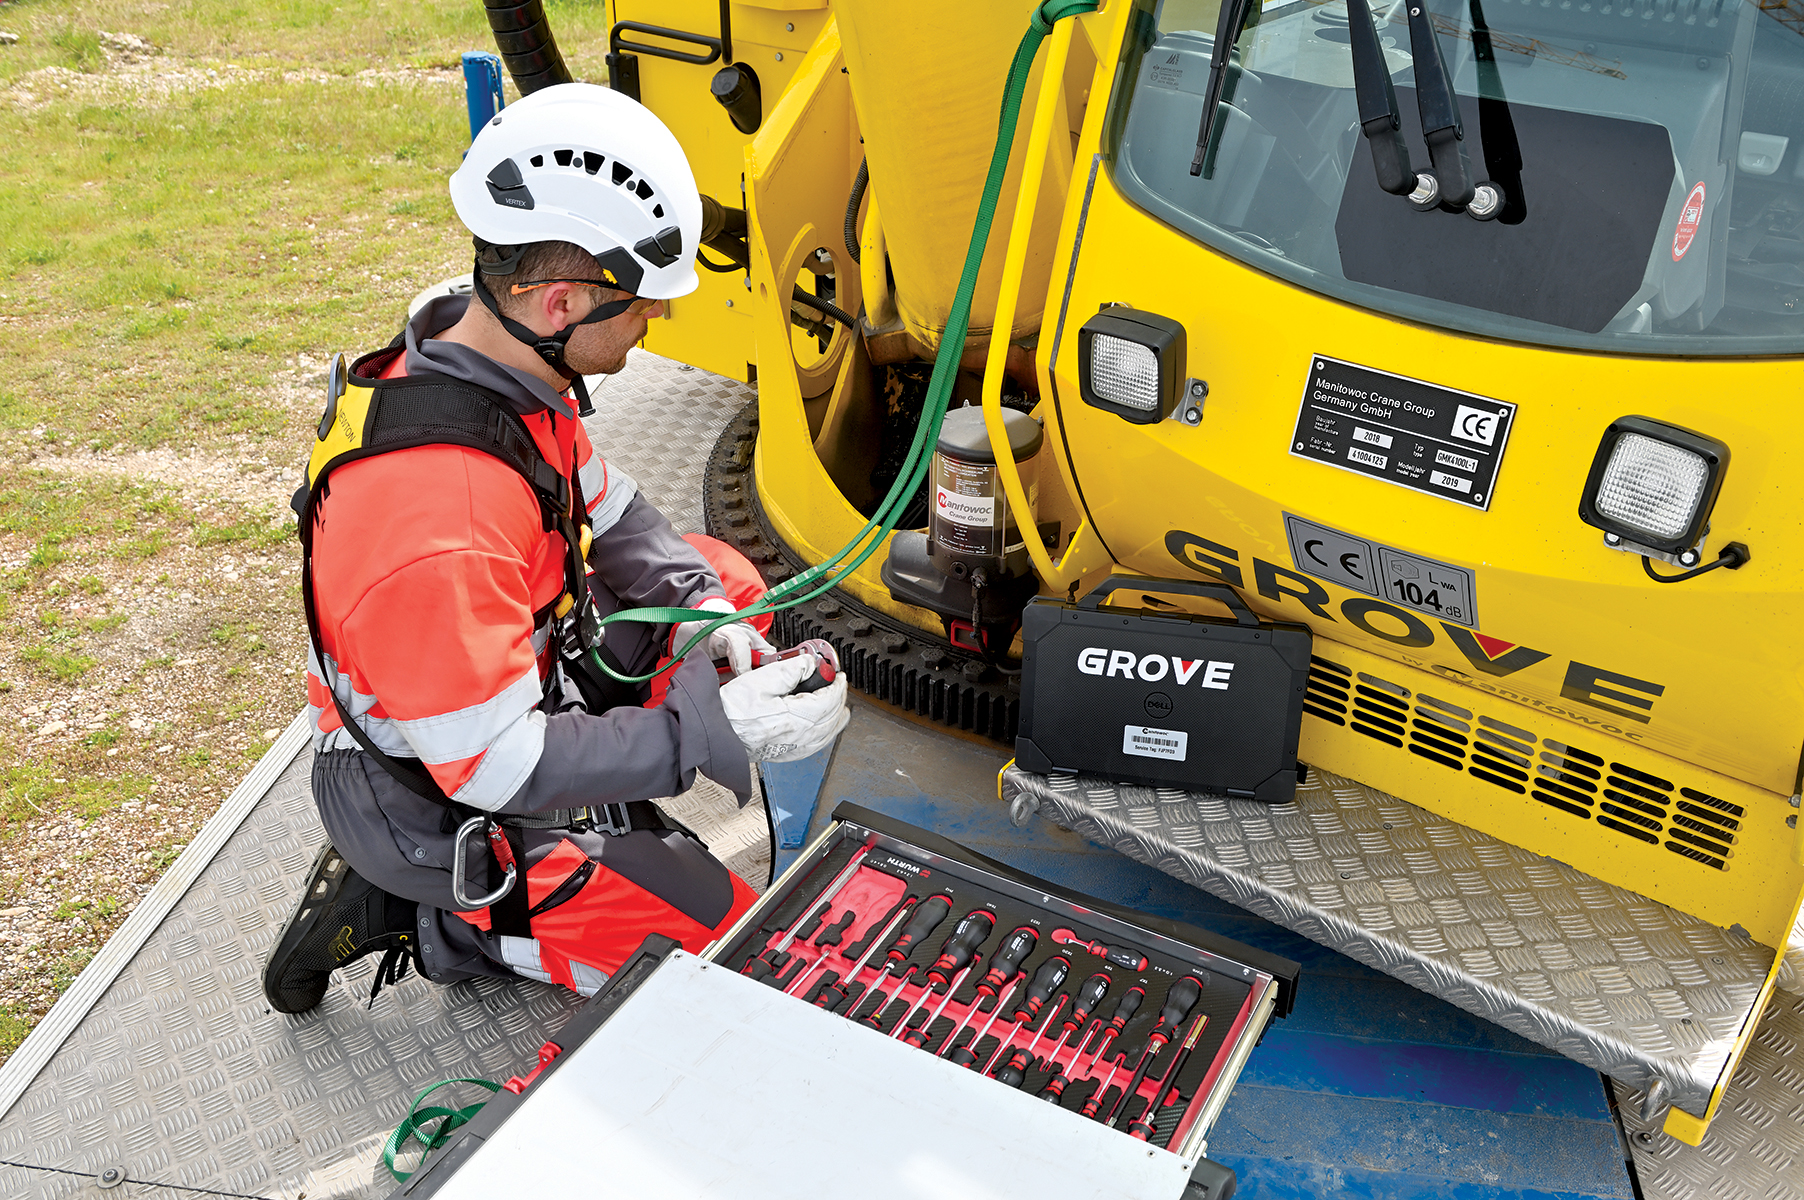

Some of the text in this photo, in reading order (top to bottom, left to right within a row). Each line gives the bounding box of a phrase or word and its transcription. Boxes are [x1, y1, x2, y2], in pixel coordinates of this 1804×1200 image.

[505, 198, 526, 207] VERTEX
[1313, 390, 1392, 419] Germany GmbH
[1315, 377, 1436, 419] Manitowoc Crane Group
[338, 408, 356, 443] NEWTON
[1364, 431, 1381, 443] 2018
[1352, 449, 1384, 466] 41004125
[1441, 475, 1459, 488] 2019
[949, 510, 988, 523] Crane Group
[1393, 578, 1462, 619] 104 dB
[1165, 529, 1666, 725] GROVE
[1077, 647, 1235, 691] GROVE
[1402, 655, 1424, 667] by
[1147, 701, 1170, 710] DELL
